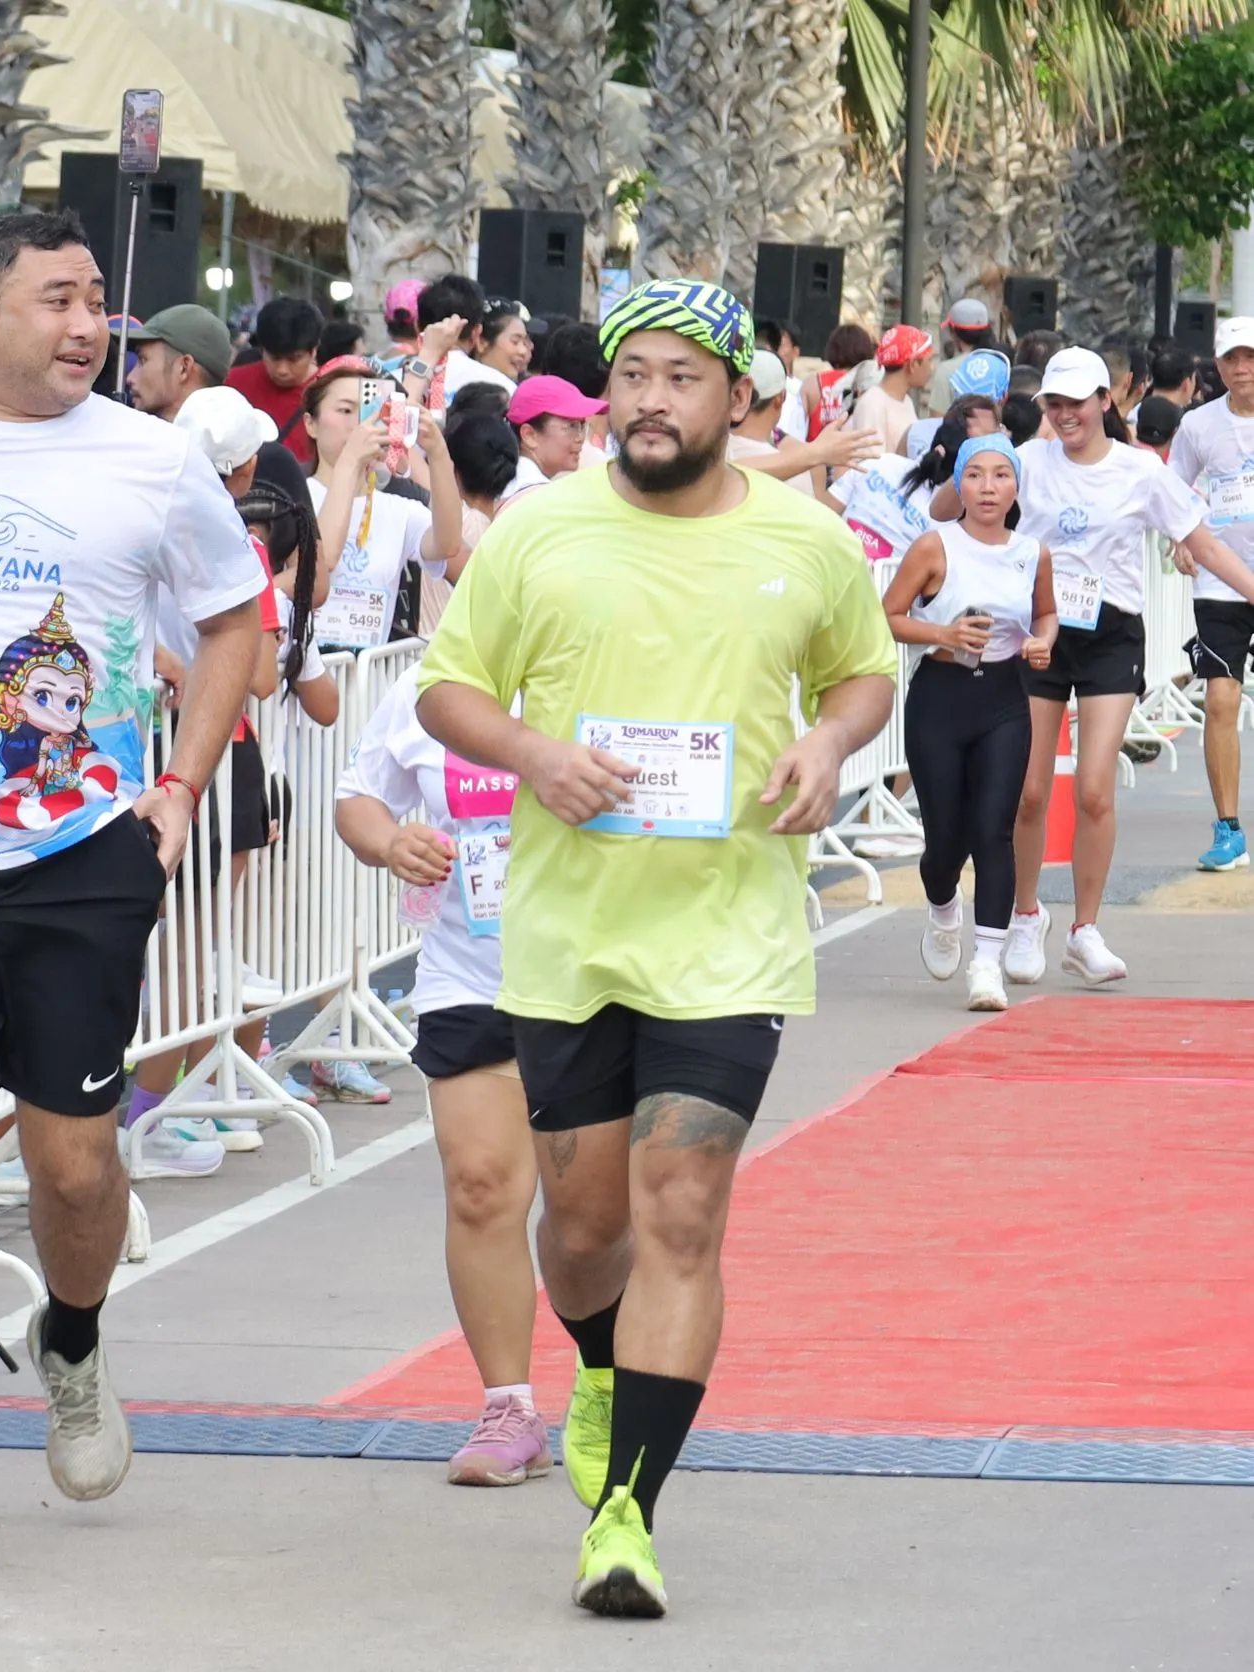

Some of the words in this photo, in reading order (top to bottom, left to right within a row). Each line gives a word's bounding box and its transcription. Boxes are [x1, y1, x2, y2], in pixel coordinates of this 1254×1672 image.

[1082, 576, 1099, 589] 5K
[369, 593, 384, 606] 5K
[348, 612, 382, 629] 5499
[621, 725, 680, 741] LOMARUN
[689, 732, 721, 751] 5K
[470, 873, 484, 896] F
